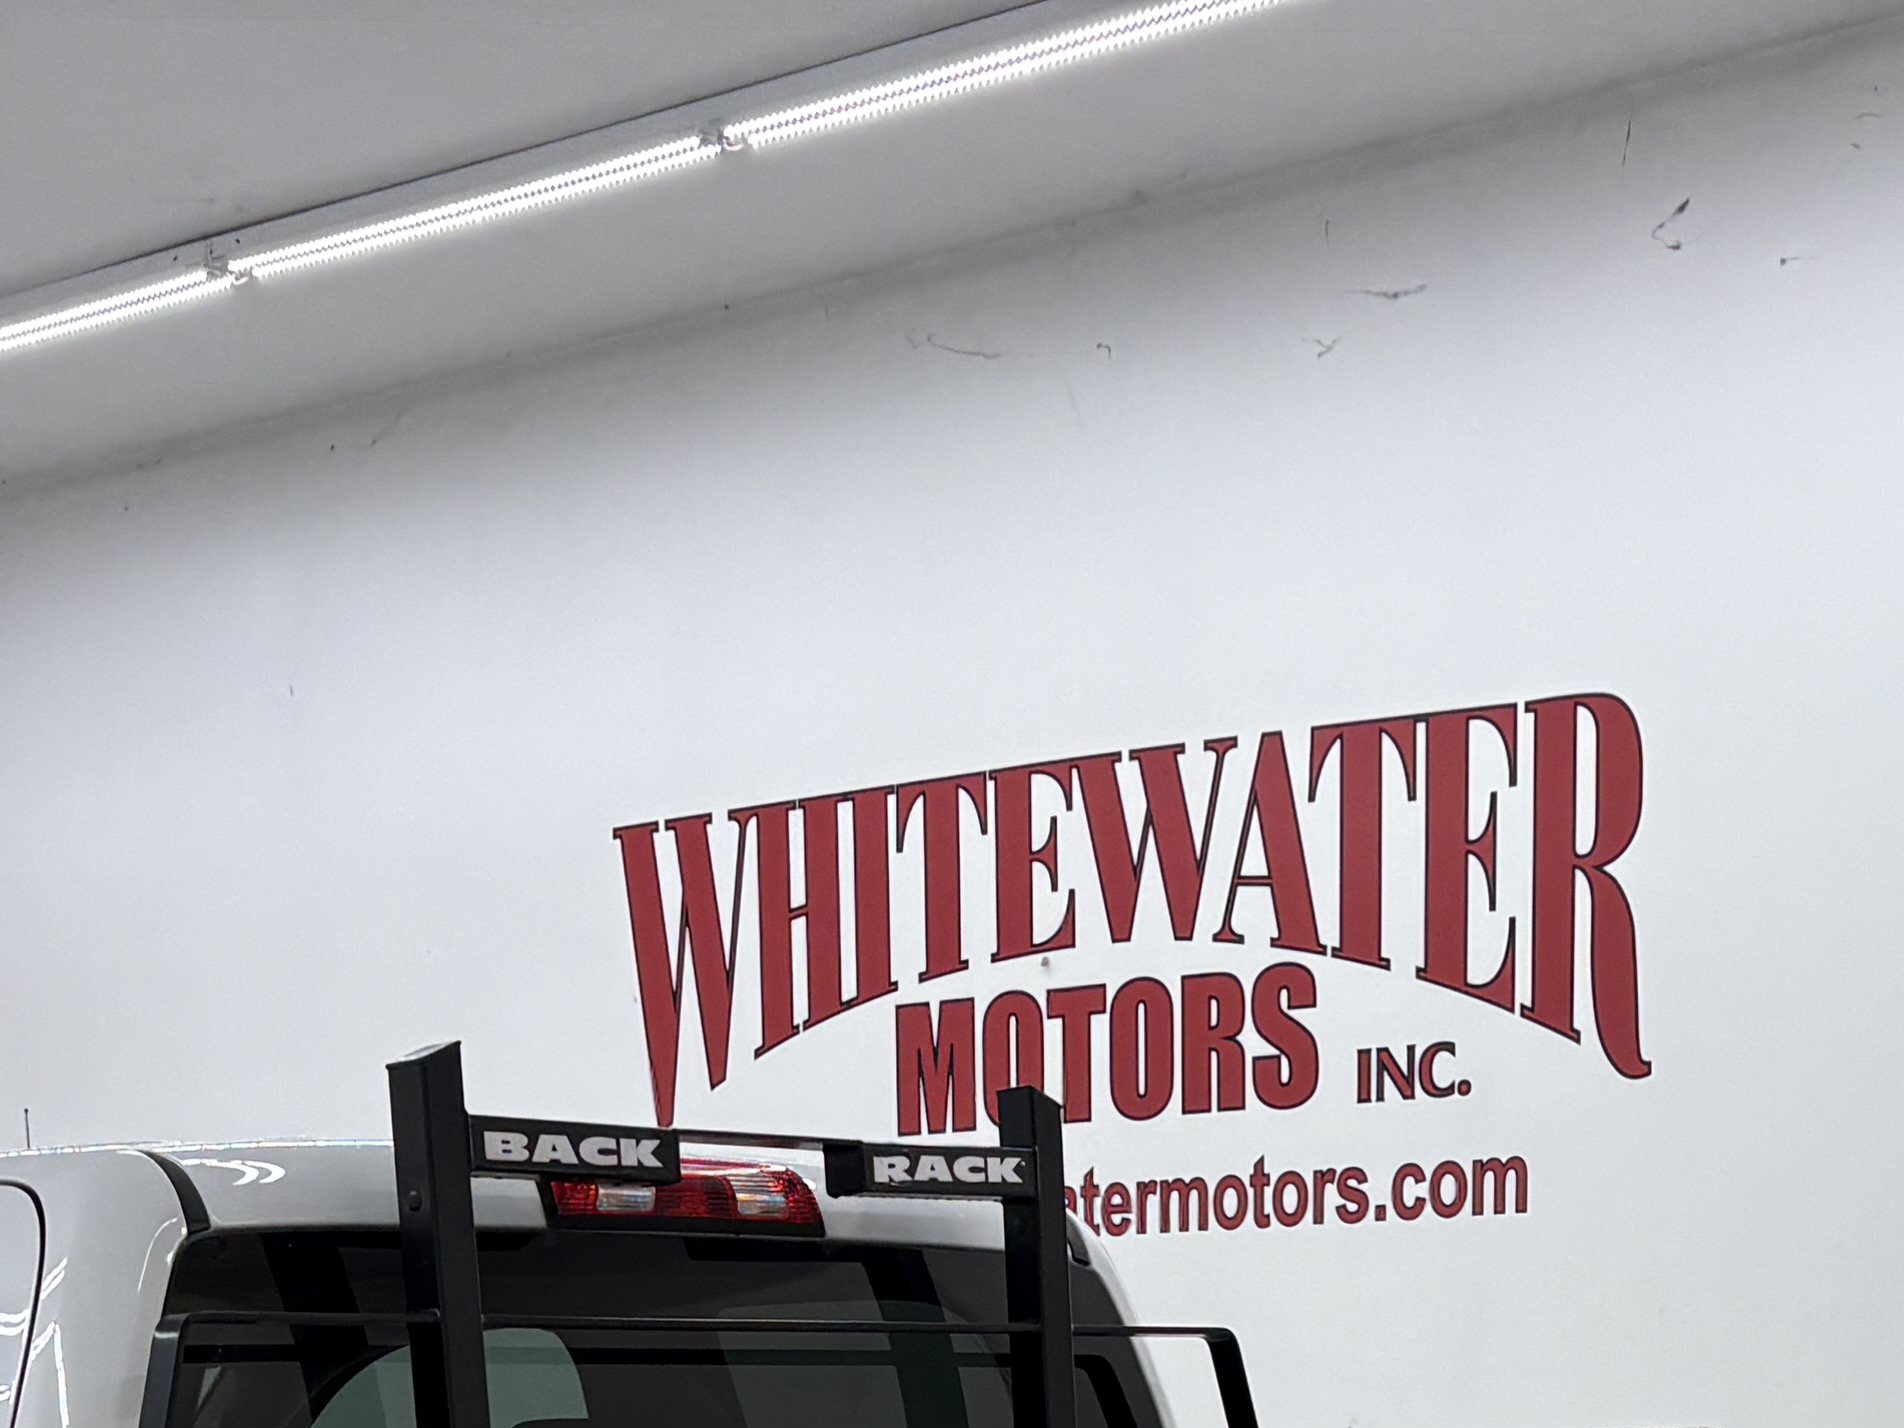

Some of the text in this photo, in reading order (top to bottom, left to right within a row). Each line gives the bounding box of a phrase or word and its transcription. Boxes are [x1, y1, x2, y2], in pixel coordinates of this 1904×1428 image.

[613, 692, 1652, 1128] WHITEWATER
[895, 961, 1473, 1137] MOTORS INC.
[482, 1130, 1026, 1185] BACK RACK
[1065, 1153, 1530, 1238] termotors.com
